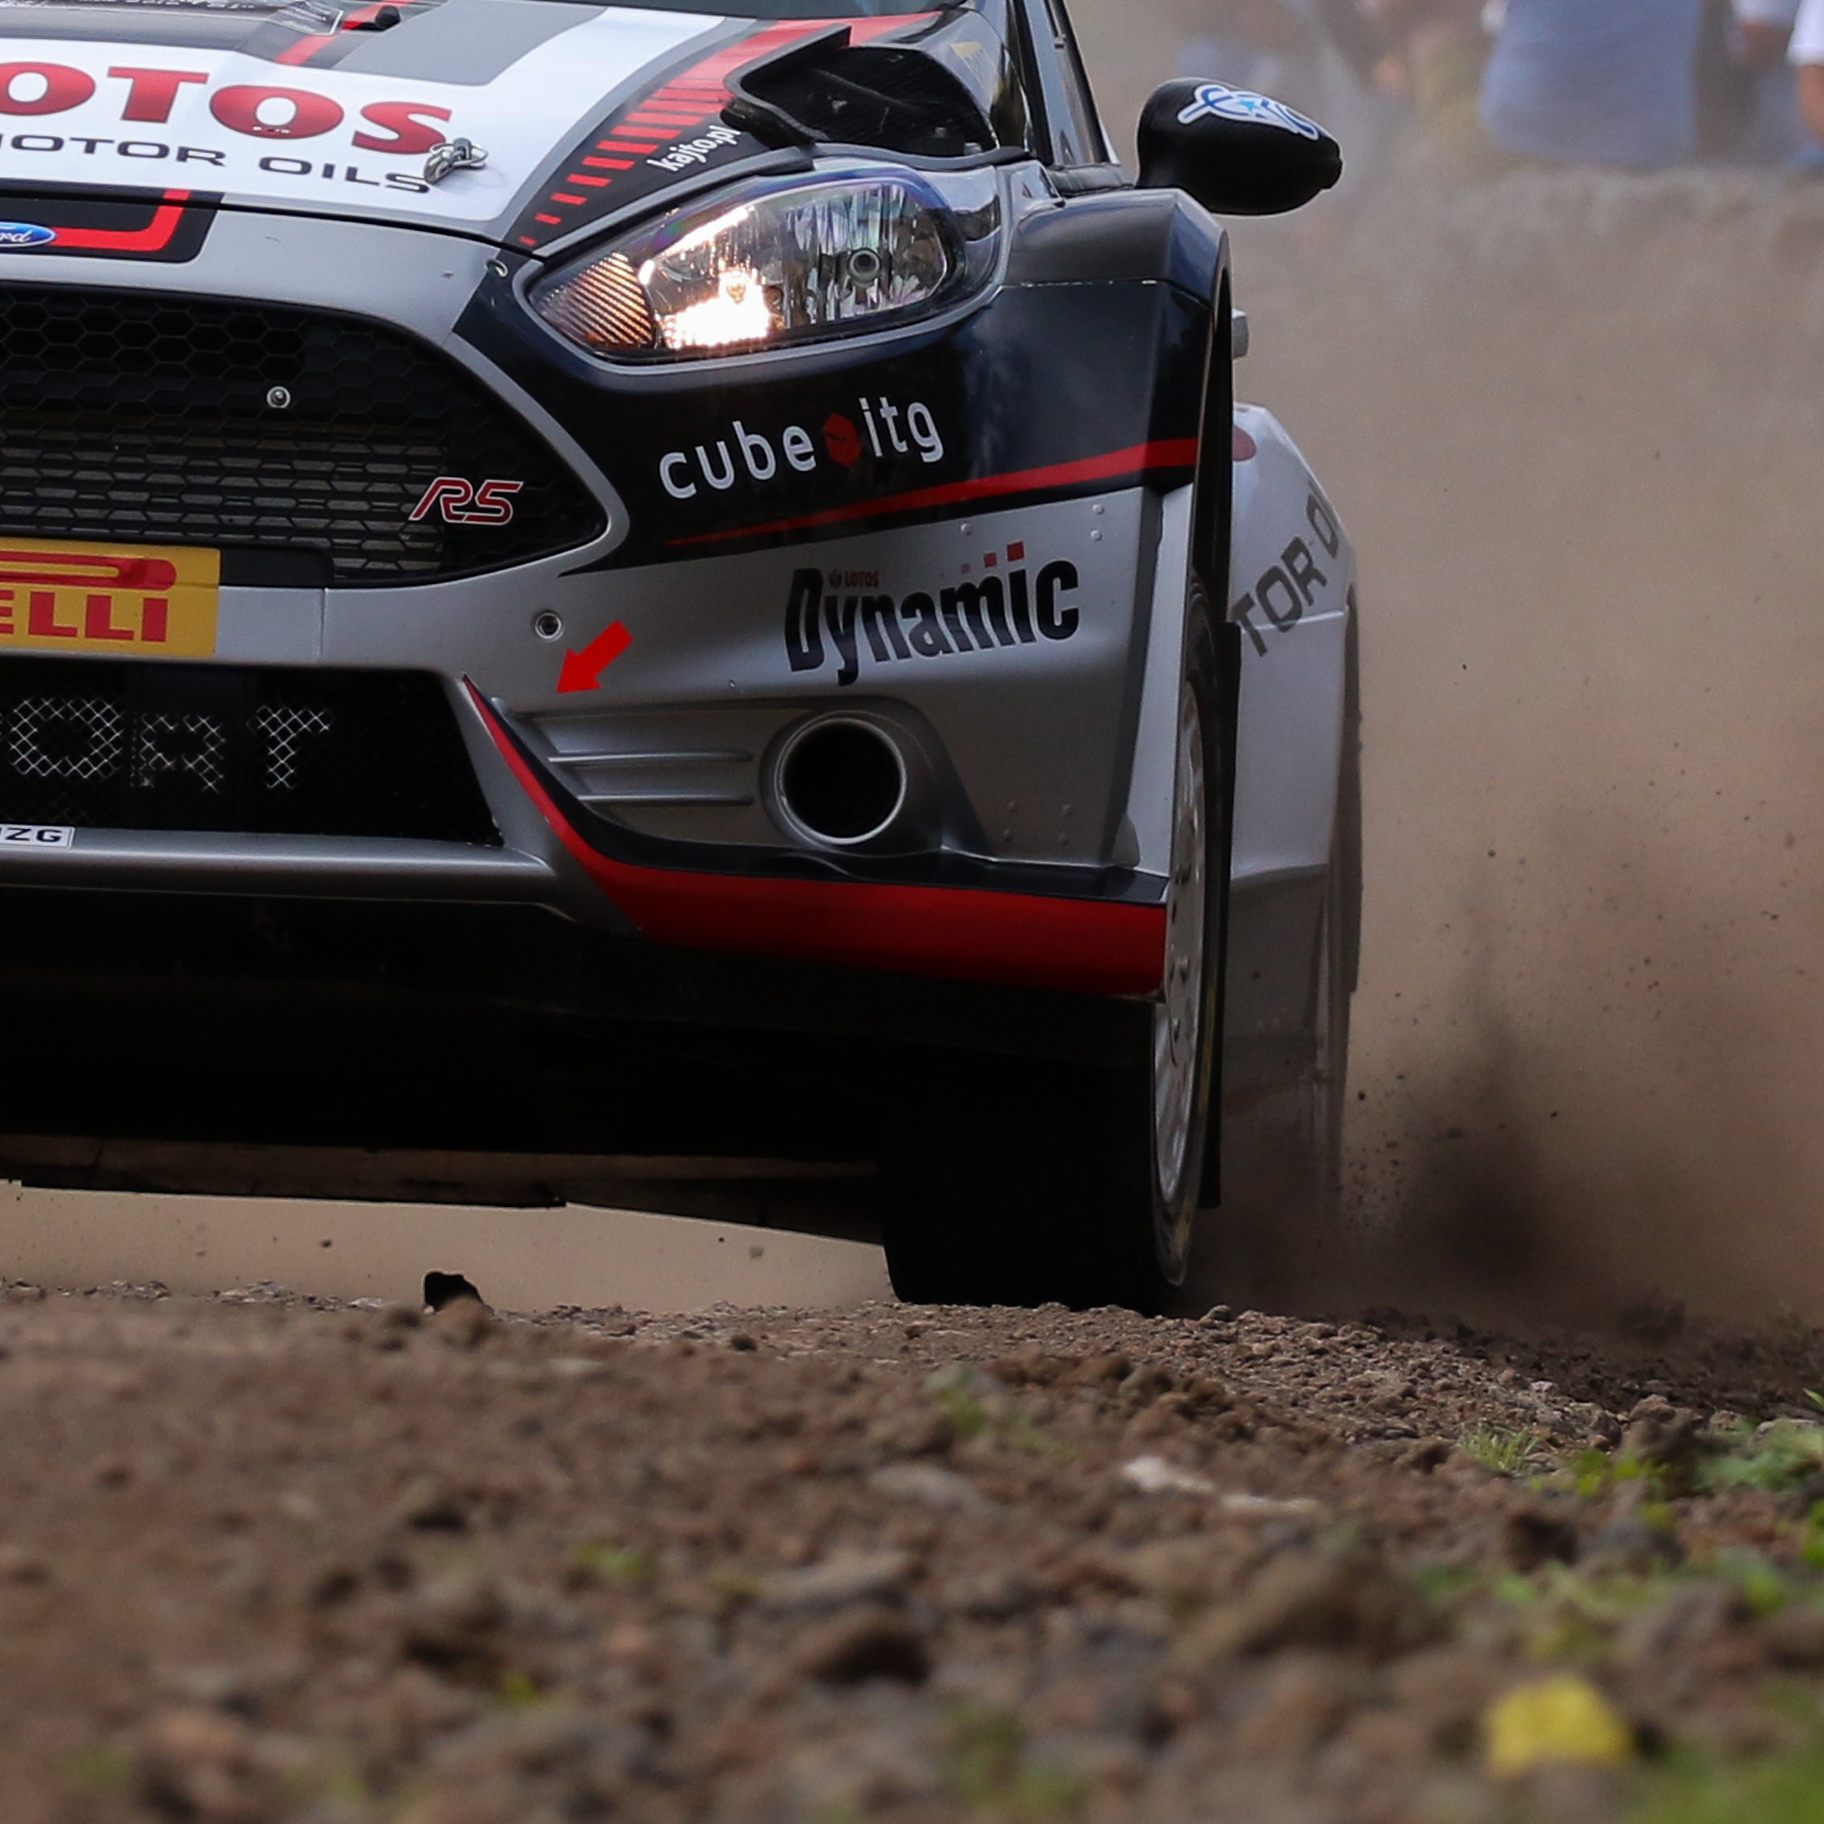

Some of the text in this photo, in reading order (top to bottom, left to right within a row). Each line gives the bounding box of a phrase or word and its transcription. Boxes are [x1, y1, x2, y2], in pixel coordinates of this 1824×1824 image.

[646, 124, 741, 173] kajto.pl
[258, 156, 432, 194] OILS
[658, 397, 945, 500] cube itg
[409, 476, 524, 526] RS
[844, 570, 880, 588] LOTOS
[783, 558, 1081, 686] Dynamic
